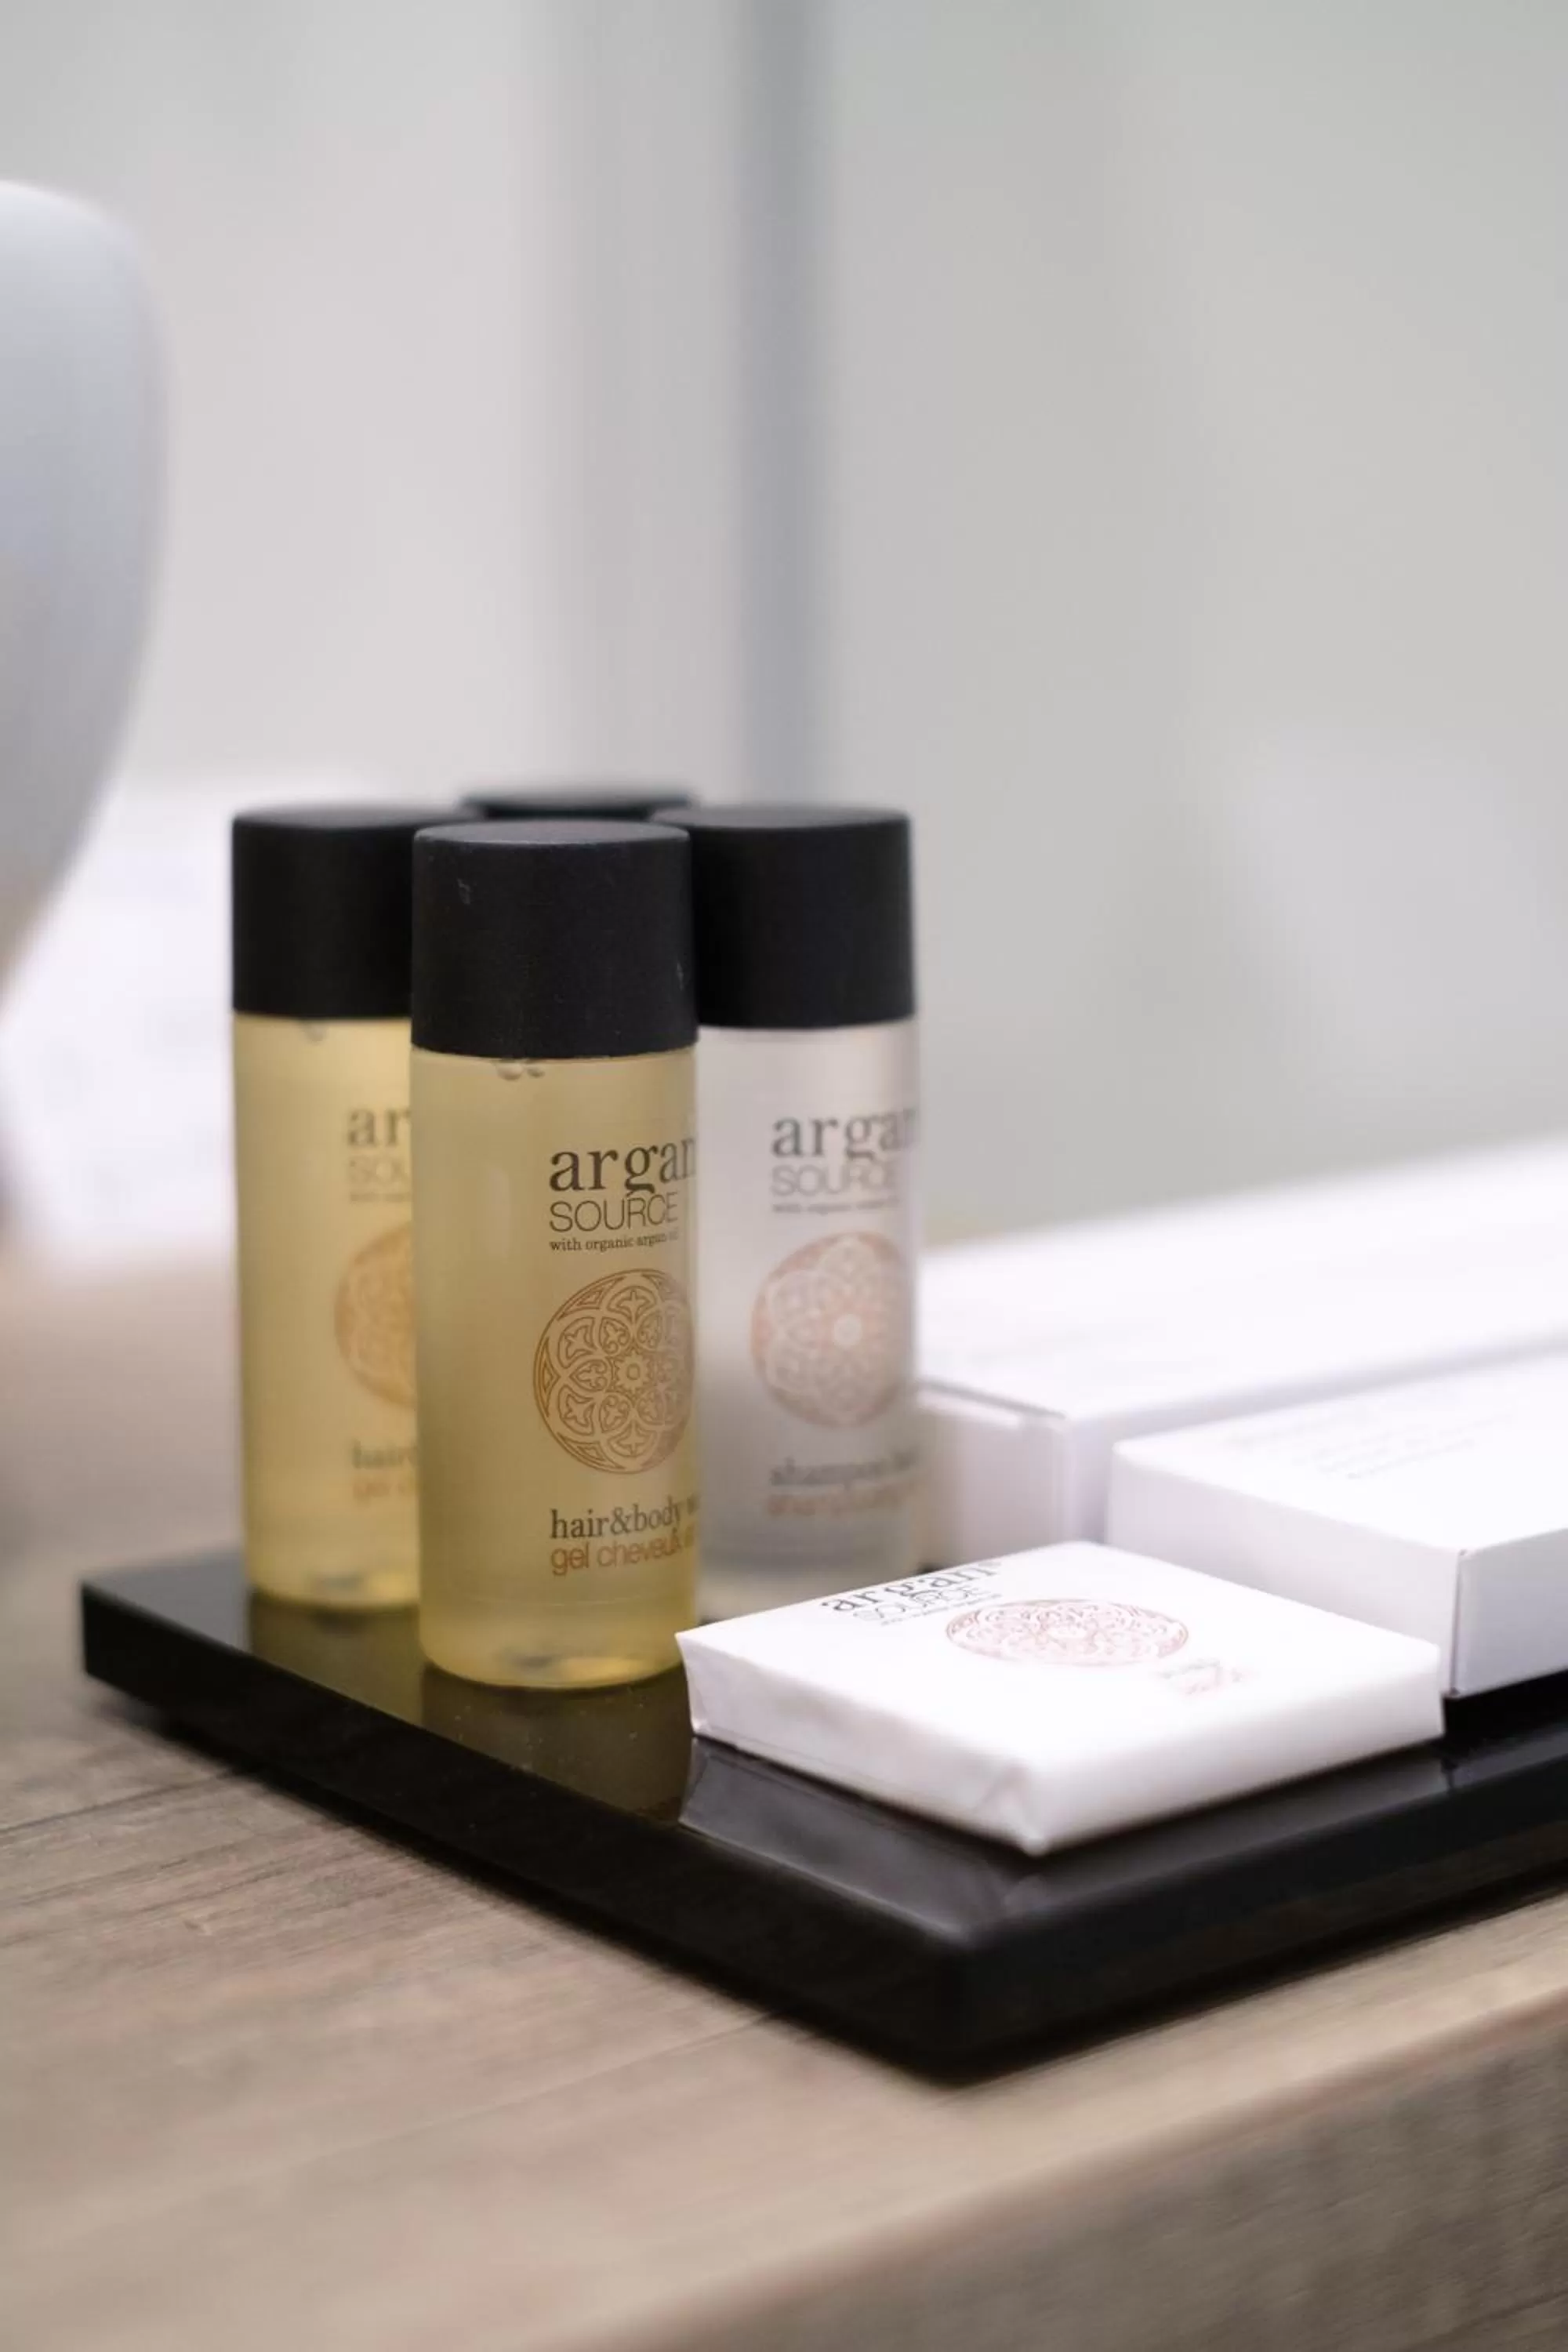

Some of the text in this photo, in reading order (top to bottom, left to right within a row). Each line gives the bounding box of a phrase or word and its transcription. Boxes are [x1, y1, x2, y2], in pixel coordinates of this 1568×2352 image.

[550, 1191, 679, 1232] SOURCE
[550, 1237, 582, 1252] with
[585, 1235, 633, 1253] organic
[550, 1494, 683, 1539] hair&body
[550, 1541, 590, 1577] gel
